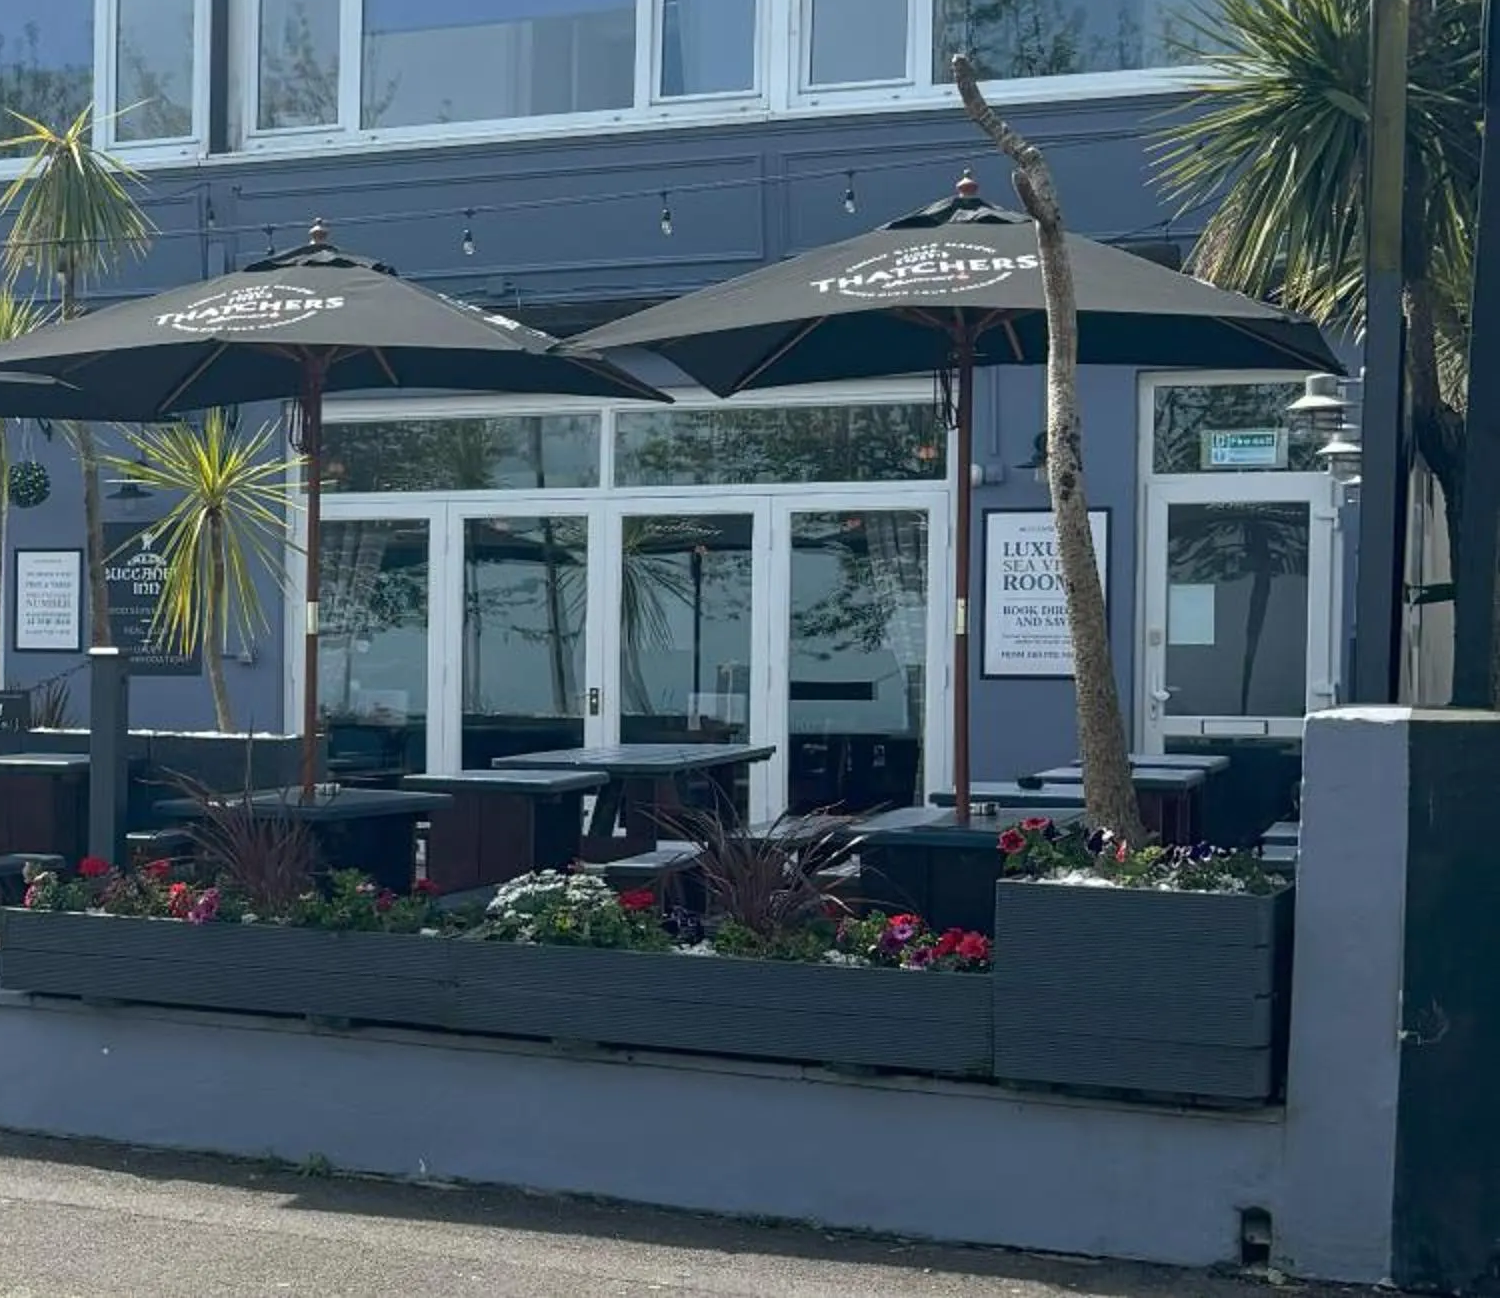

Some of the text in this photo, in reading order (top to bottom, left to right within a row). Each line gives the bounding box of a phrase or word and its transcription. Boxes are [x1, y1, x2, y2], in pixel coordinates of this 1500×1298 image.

[810, 254, 1039, 293] THATCHERS
[155, 295, 346, 326] THATCHERS
[1003, 541, 1058, 557] LUXU
[1003, 559, 1036, 573] SEA
